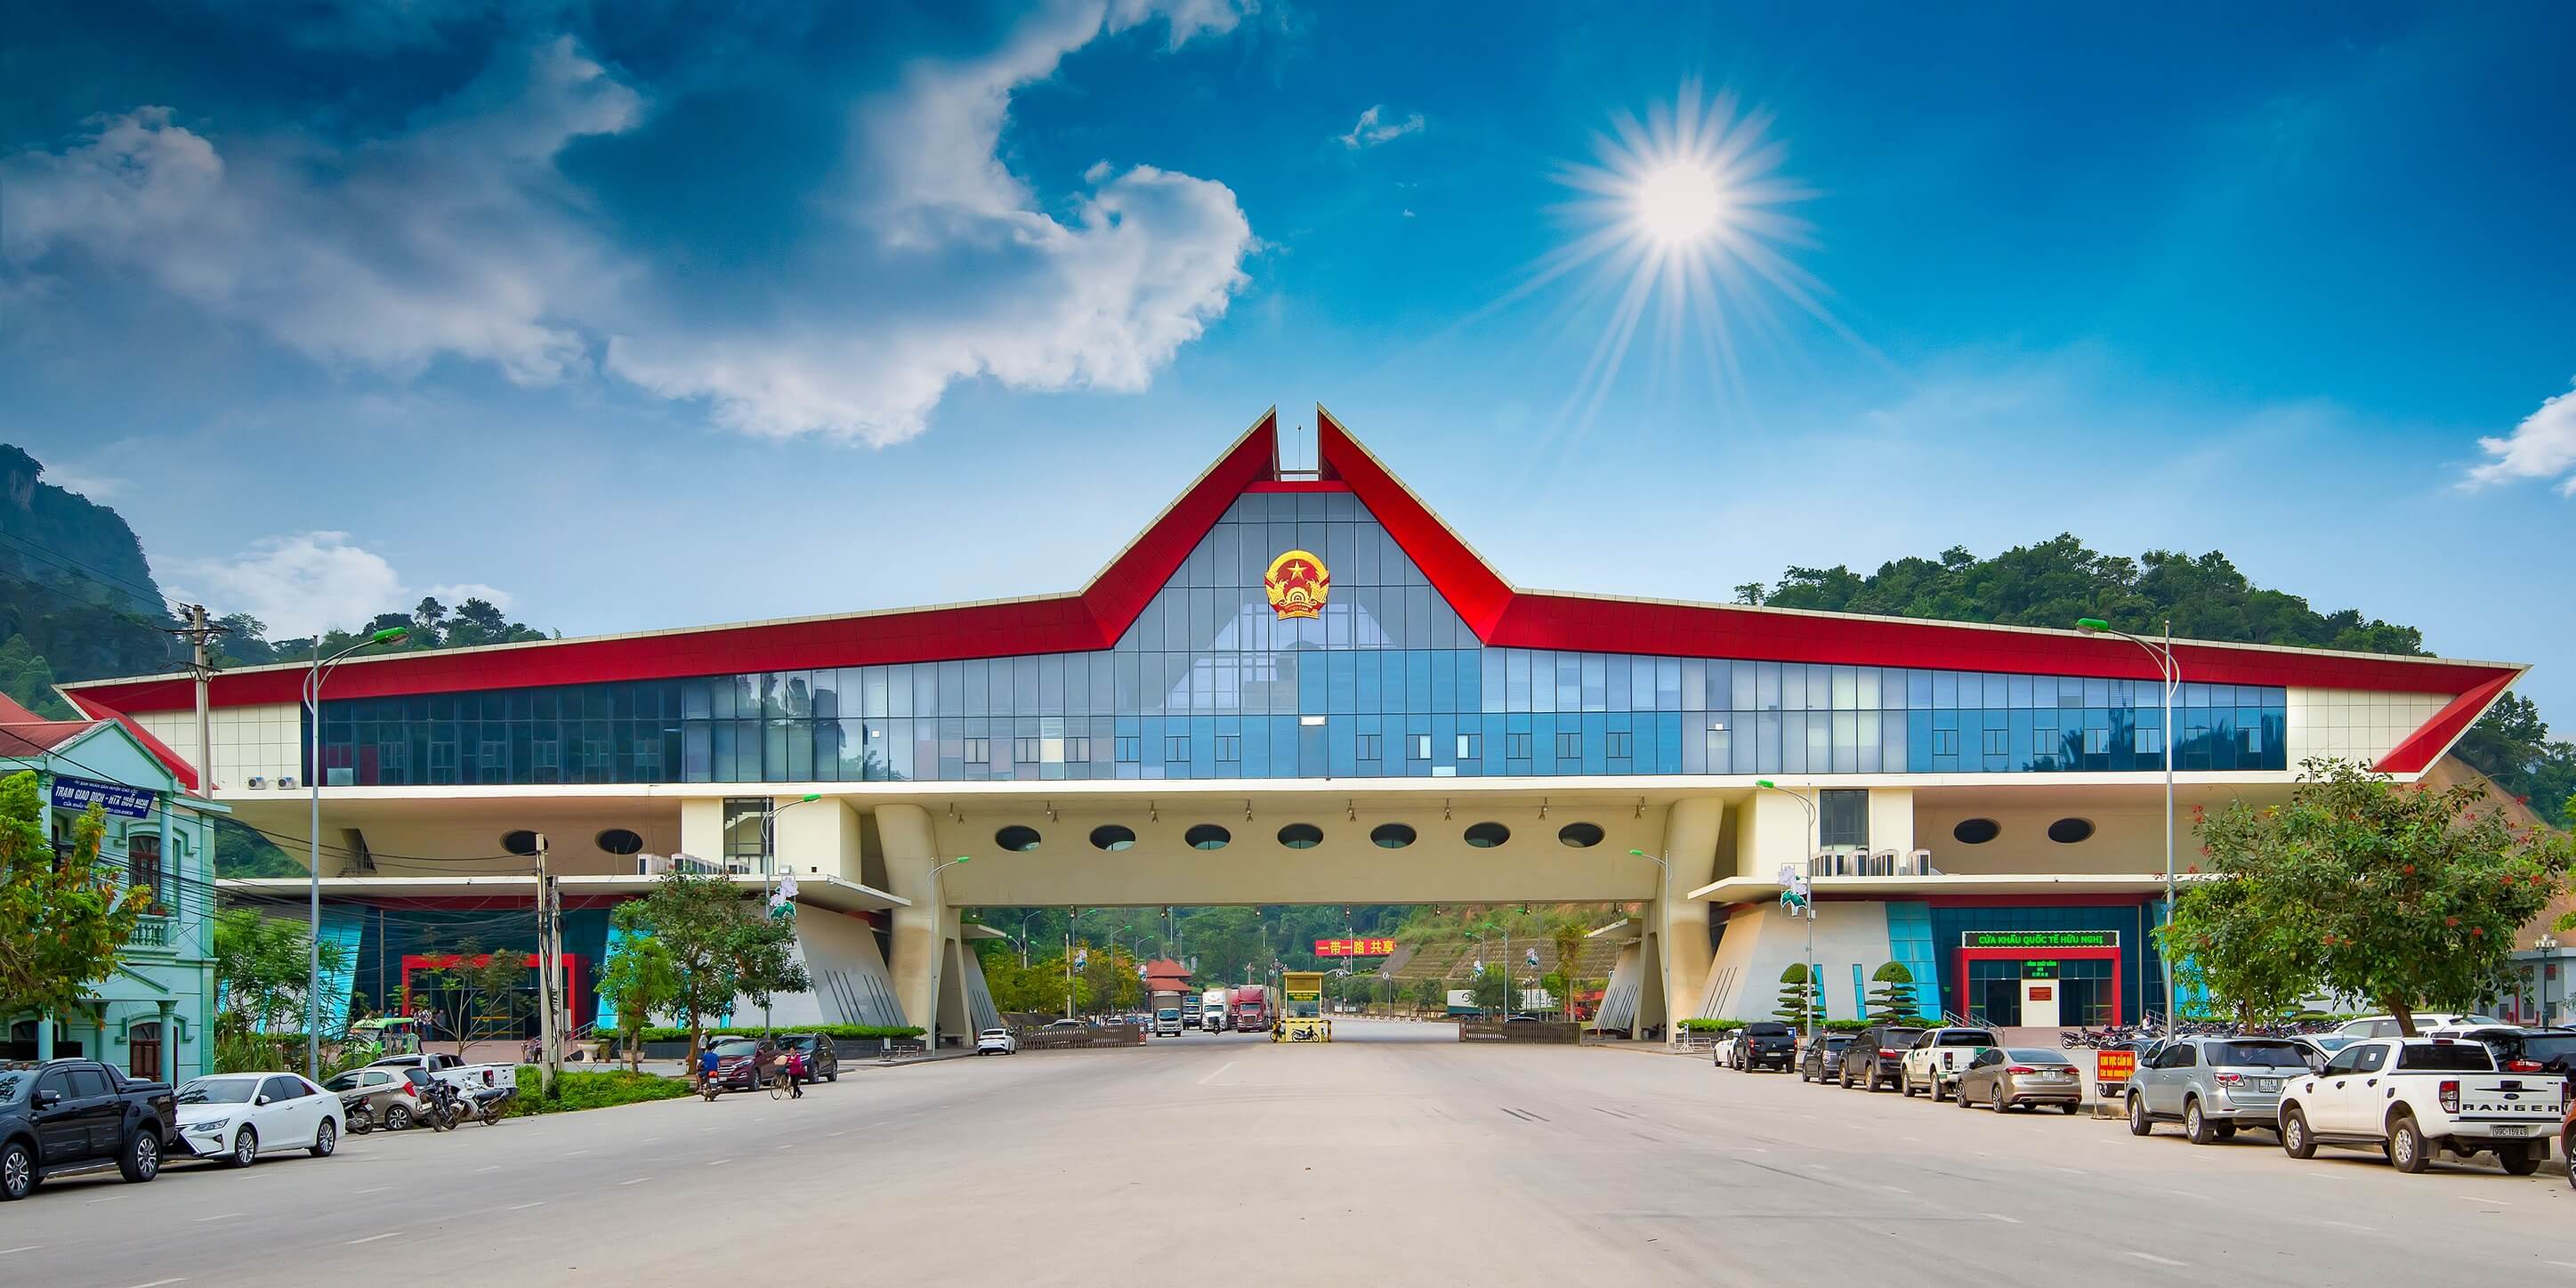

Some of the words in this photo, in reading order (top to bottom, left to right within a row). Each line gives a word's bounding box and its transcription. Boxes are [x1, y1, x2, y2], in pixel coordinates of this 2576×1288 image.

[55, 786, 74, 799] TRẠM
[75, 790, 90, 801] GIAO
[1978, 934, 1996, 944] CỬA
[1999, 934, 2021, 944] KHẨU
[2023, 934, 2047, 945] QUỐC
[2048, 934, 2059, 944] TẾ
[2060, 934, 2079, 944] HỮU
[2081, 936, 2104, 944] NGHỊ
[1318, 940, 1365, 954] 一带一路
[1370, 940, 1394, 954] 共享
[2462, 1104, 2560, 1112] RANGER
